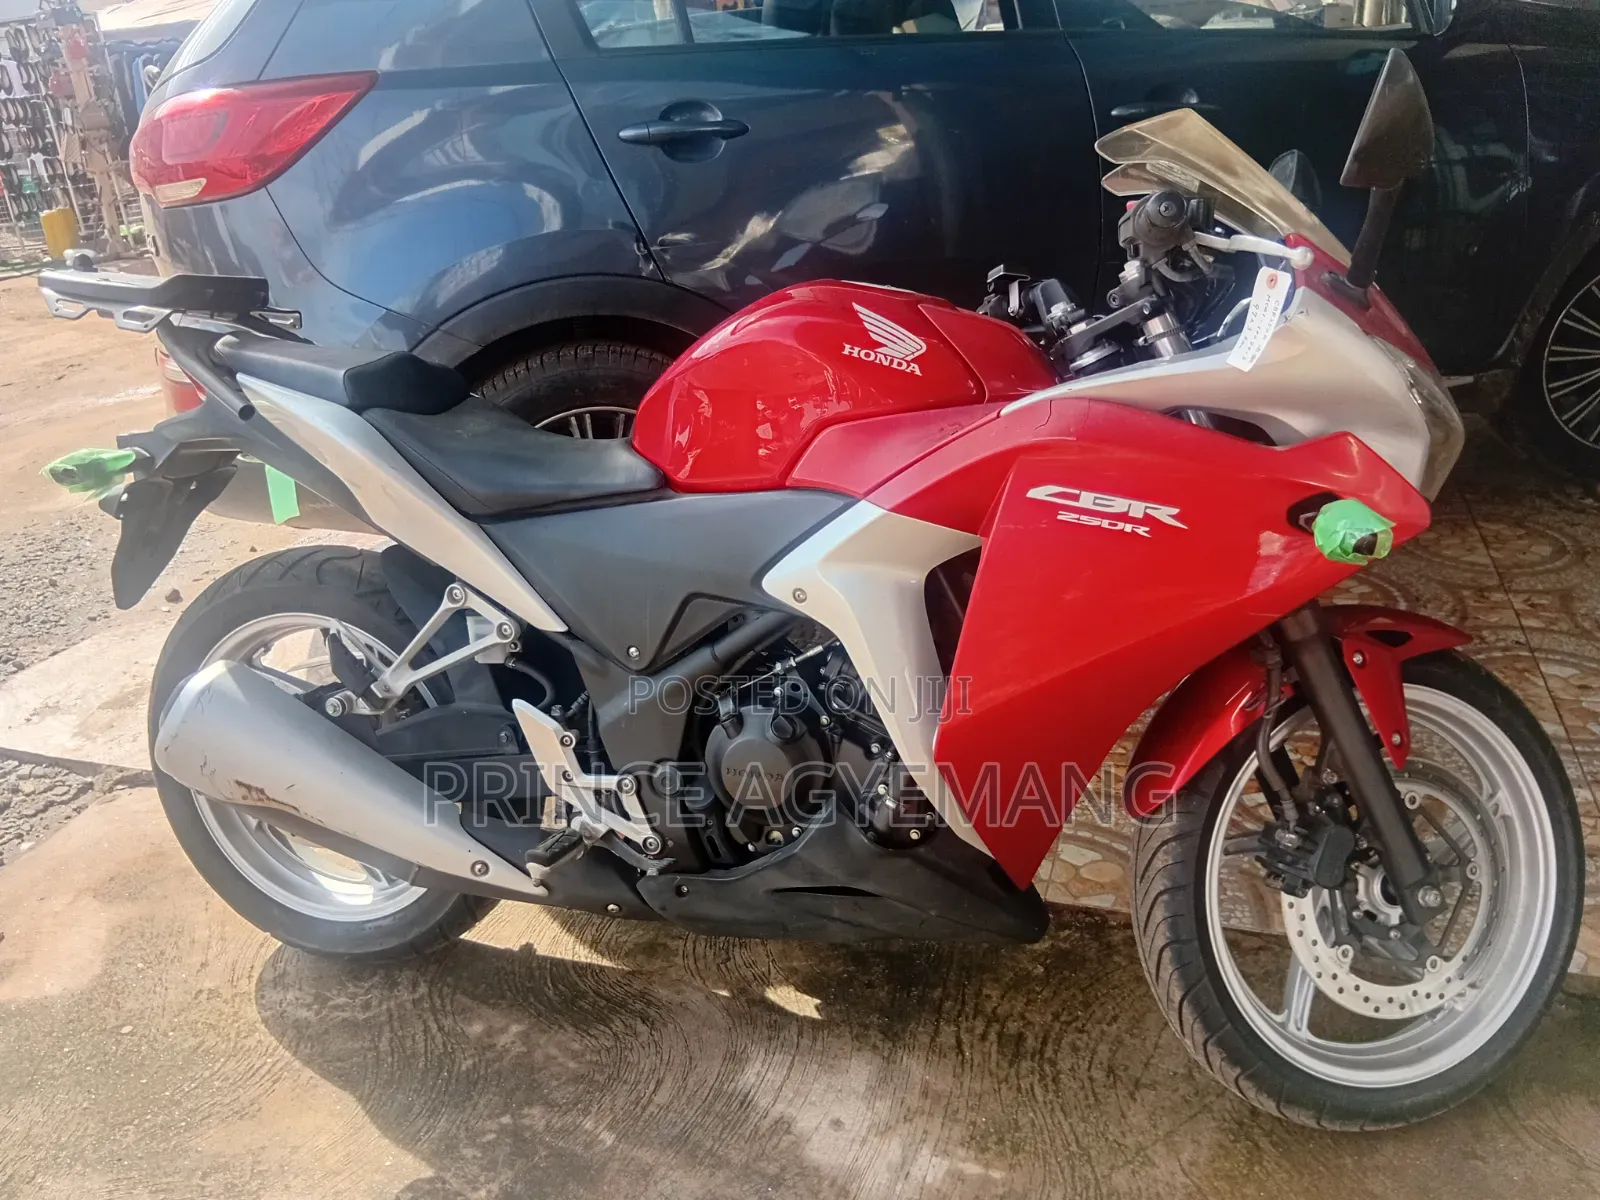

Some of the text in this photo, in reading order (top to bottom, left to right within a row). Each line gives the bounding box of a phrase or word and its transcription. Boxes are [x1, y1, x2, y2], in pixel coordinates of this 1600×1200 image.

[842, 342, 922, 376] HONDA
[1026, 485, 1188, 529] CBR
[1056, 511, 1152, 538] 250R
